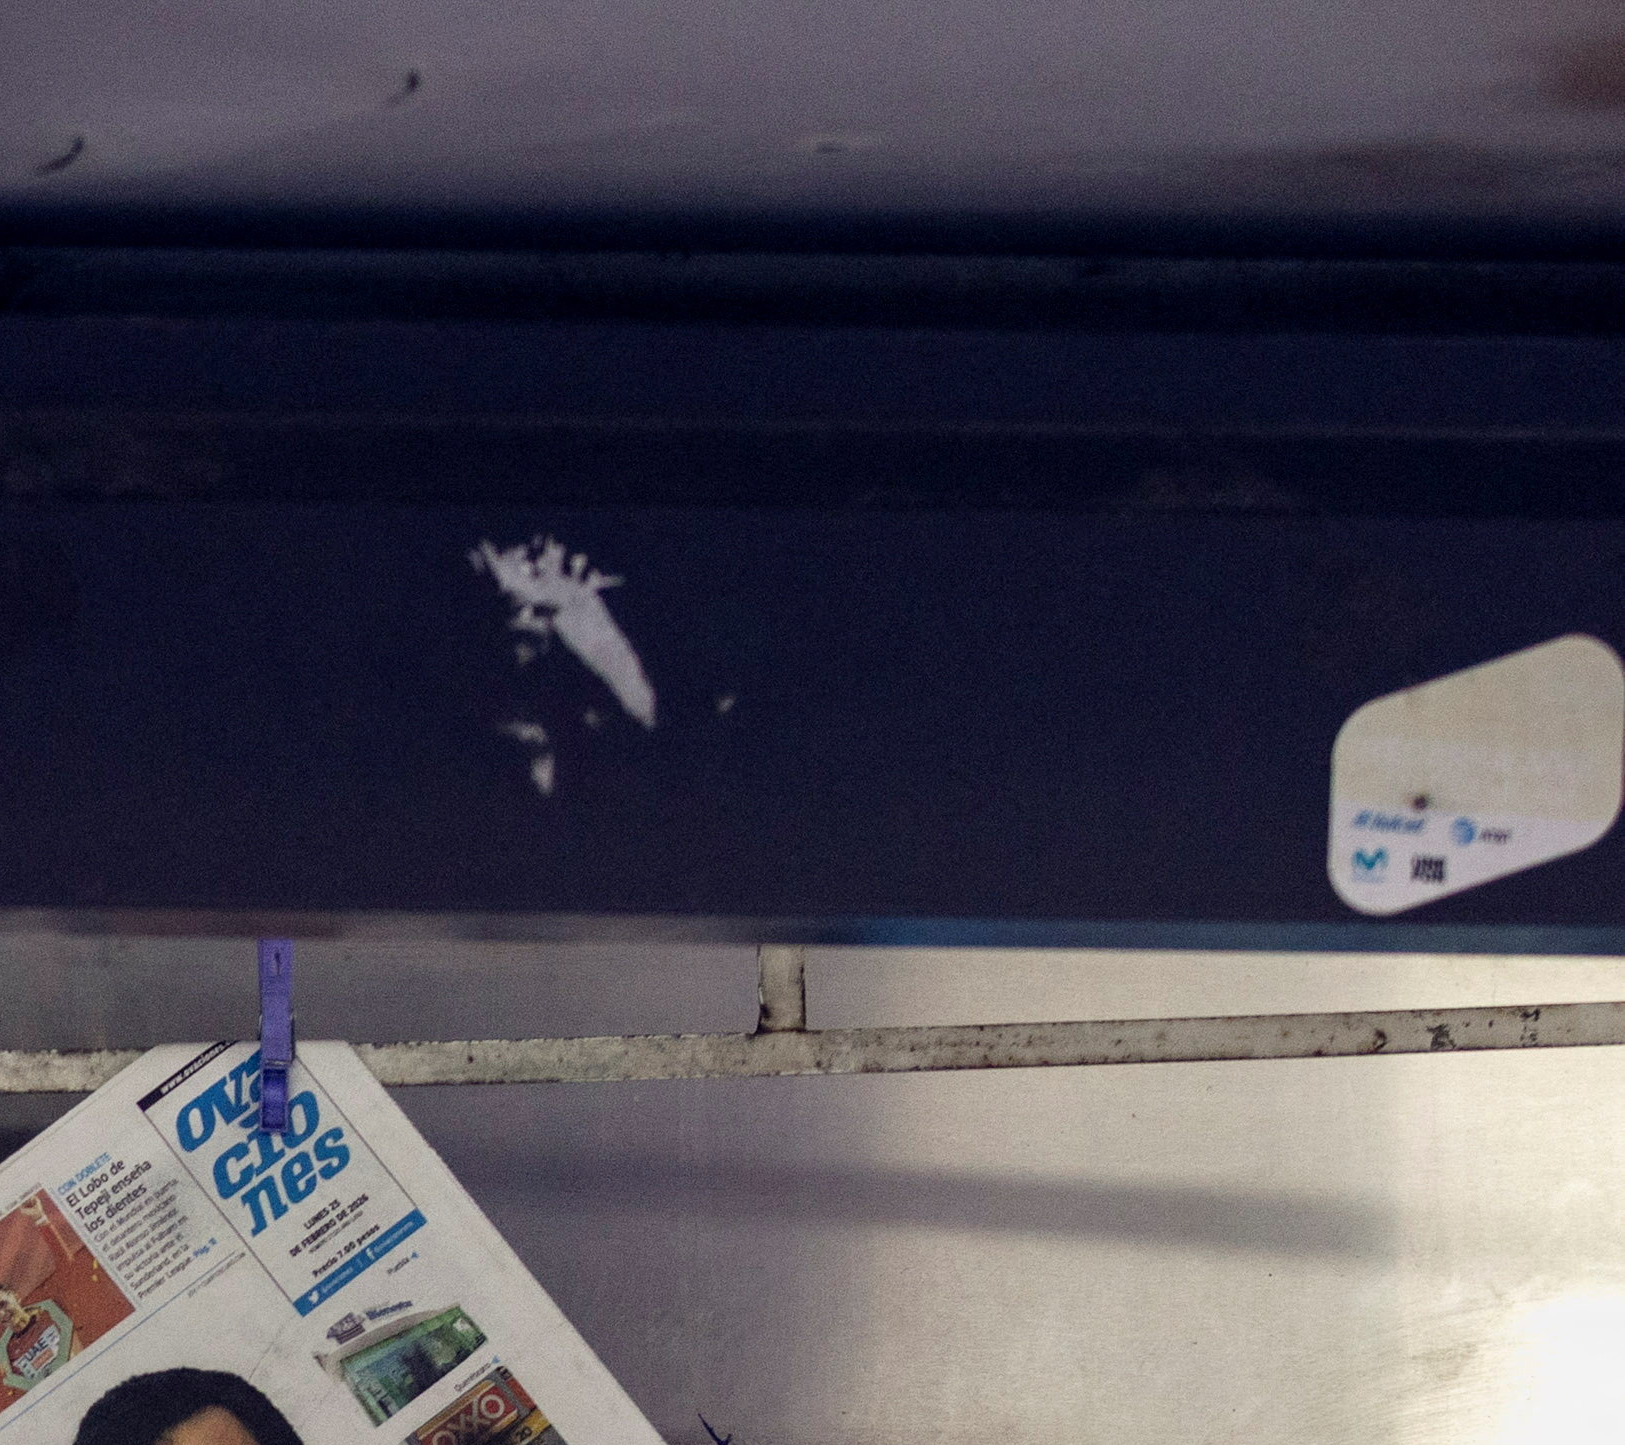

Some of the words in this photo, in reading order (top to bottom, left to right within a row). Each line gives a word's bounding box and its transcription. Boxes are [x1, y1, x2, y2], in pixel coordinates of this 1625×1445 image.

[66, 1193, 80, 1207] El
[79, 1173, 109, 1198] Lobo
[108, 1160, 125, 1176] de
[75, 1190, 112, 1219] Tepeji
[111, 1161, 152, 1194] enseña
[84, 1216, 105, 1233] los
[106, 1184, 147, 1218] dientes
[241, 1128, 350, 1236] nes
